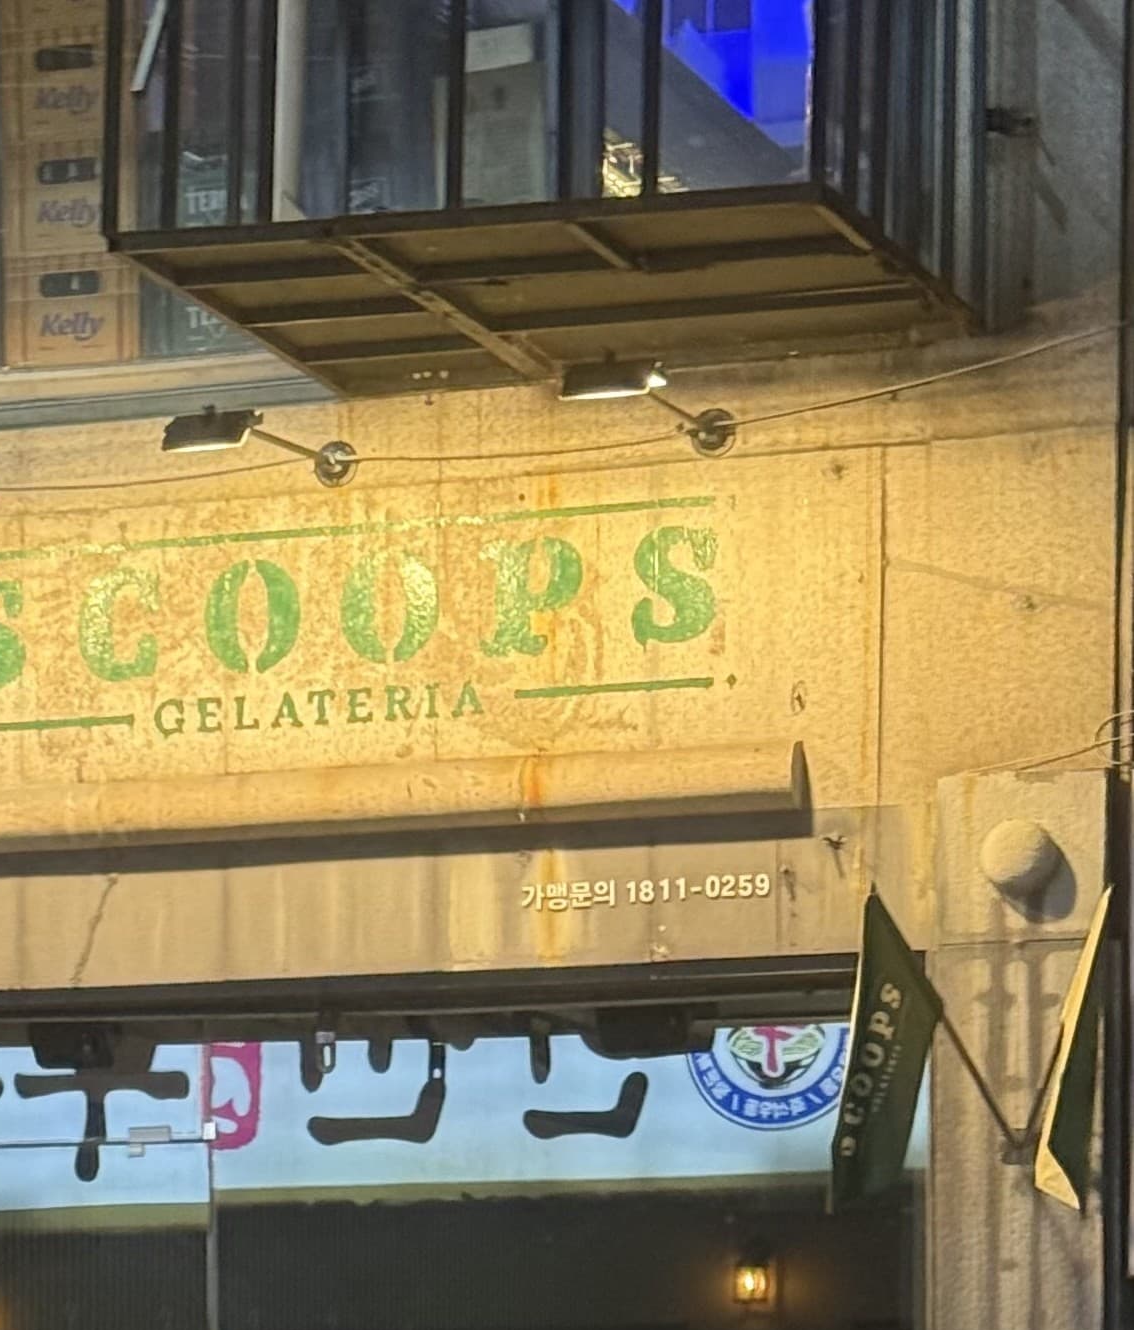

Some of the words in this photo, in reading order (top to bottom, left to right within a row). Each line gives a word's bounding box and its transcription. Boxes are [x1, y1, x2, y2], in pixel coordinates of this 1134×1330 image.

[37, 198, 100, 228] Kelly
[39, 312, 105, 341] Kelly
[152, 681, 486, 738] GELATERIA
[520, 879, 616, 914] 가맹문의
[625, 872, 771, 905] 1811-0259
